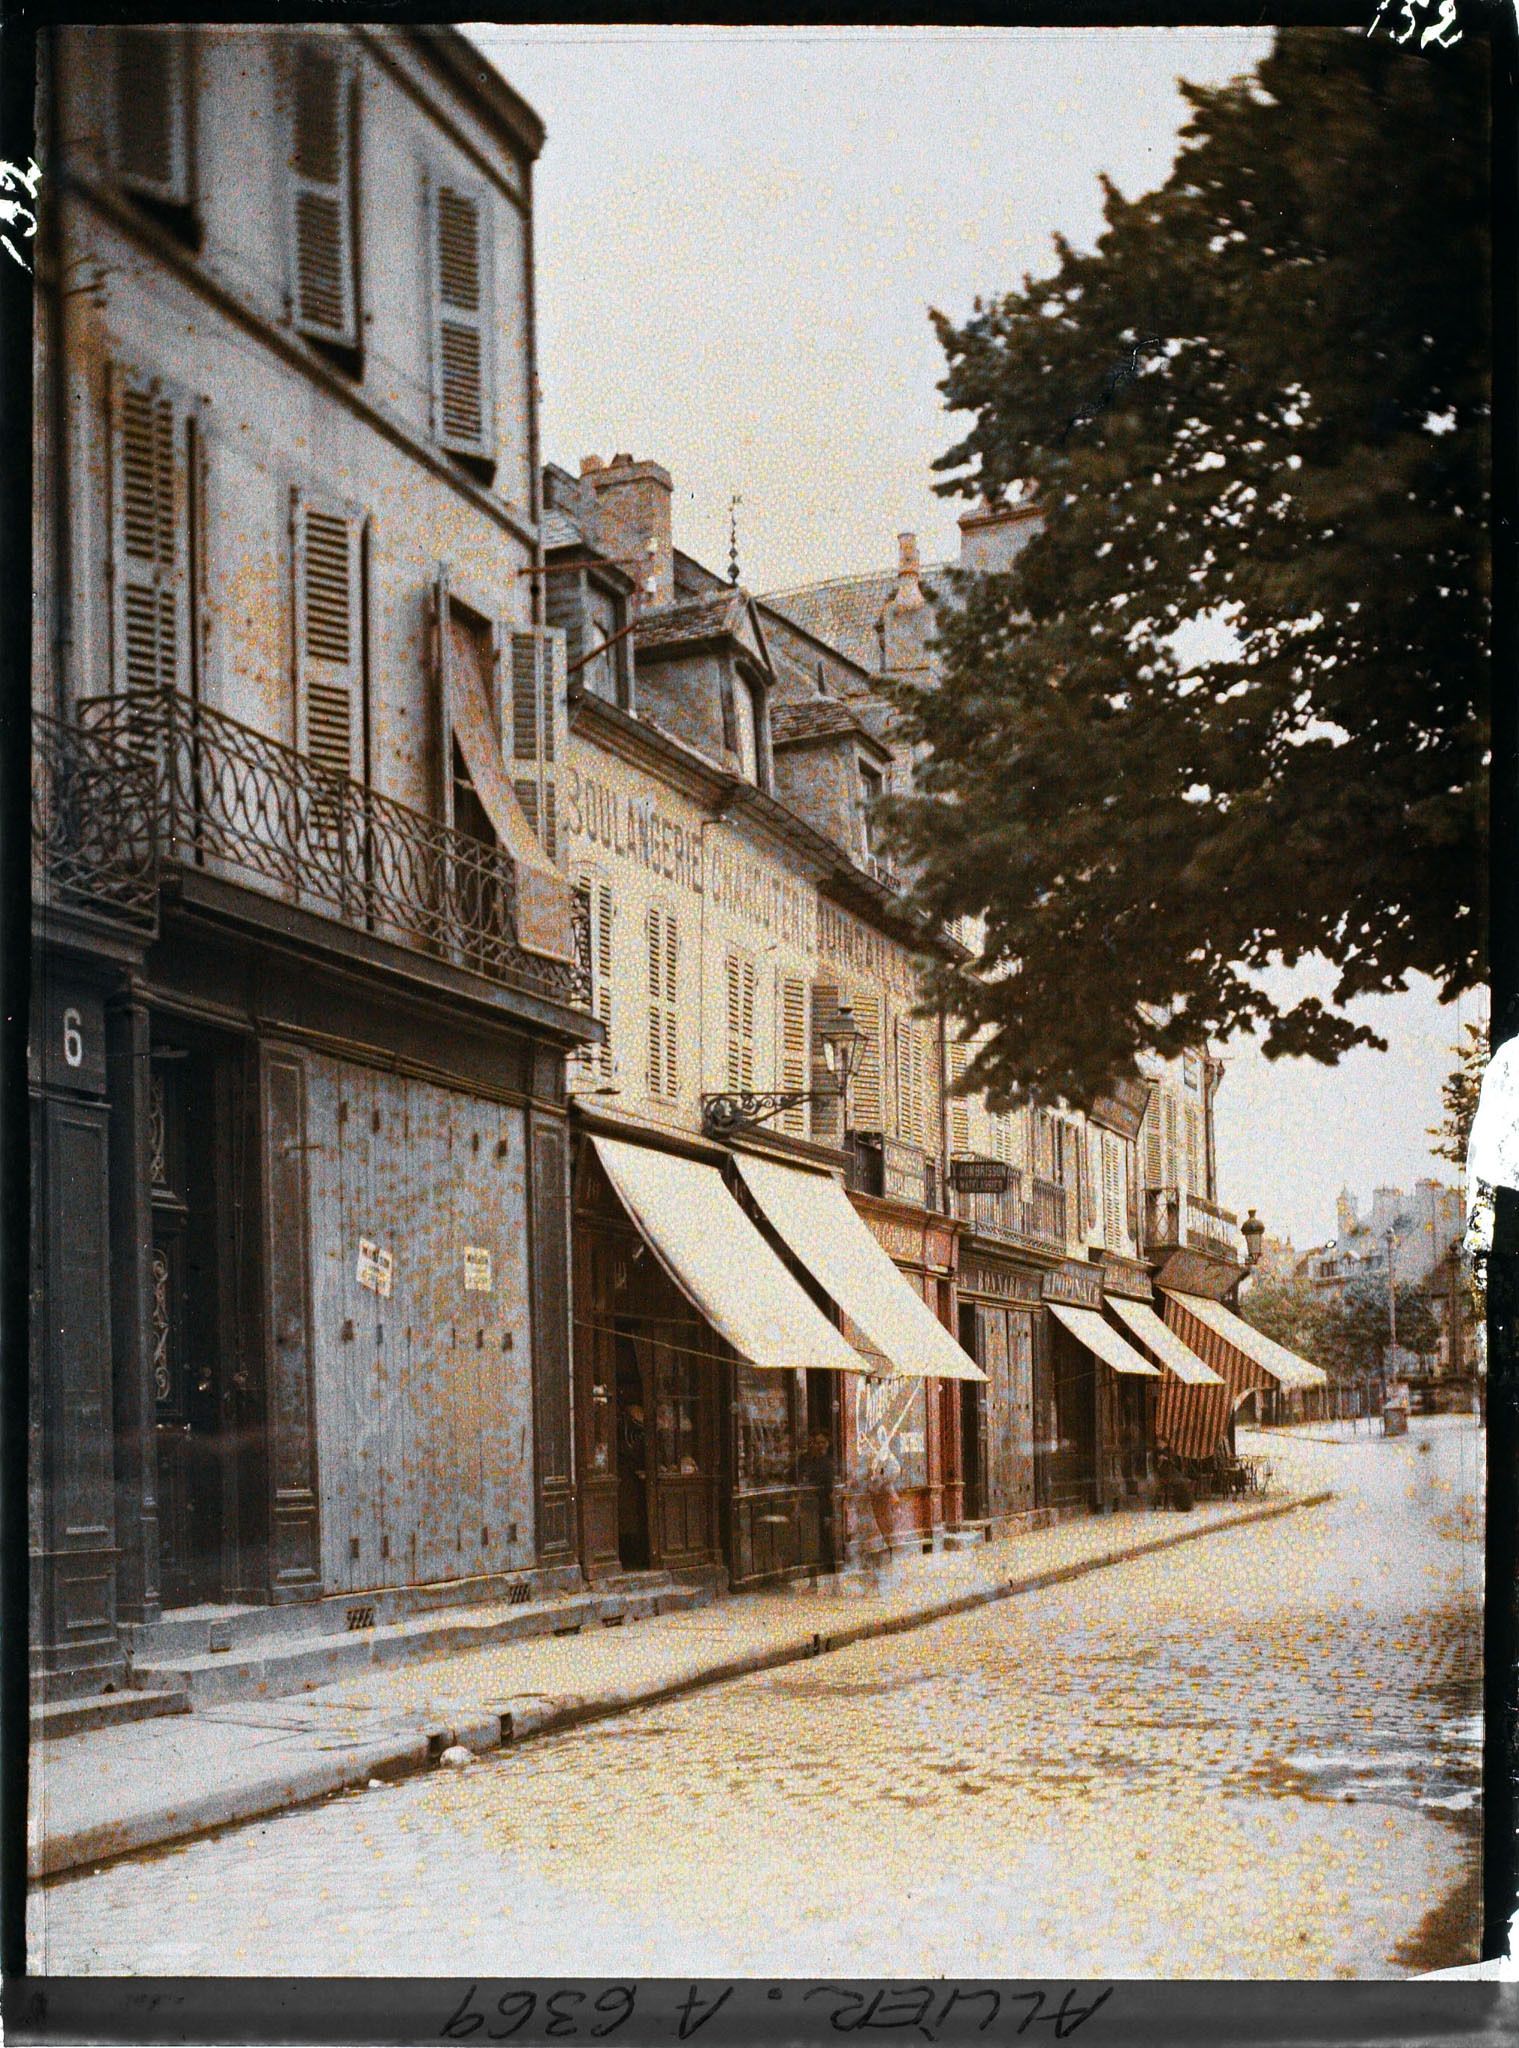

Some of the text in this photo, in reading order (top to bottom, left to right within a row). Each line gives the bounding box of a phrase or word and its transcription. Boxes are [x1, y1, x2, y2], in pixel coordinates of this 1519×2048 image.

[561, 764, 704, 895] BOULANGERIE
[63, 1007, 83, 1068] 6
[438, 1985, 637, 2040] 6369
[676, 1985, 734, 2040] A
